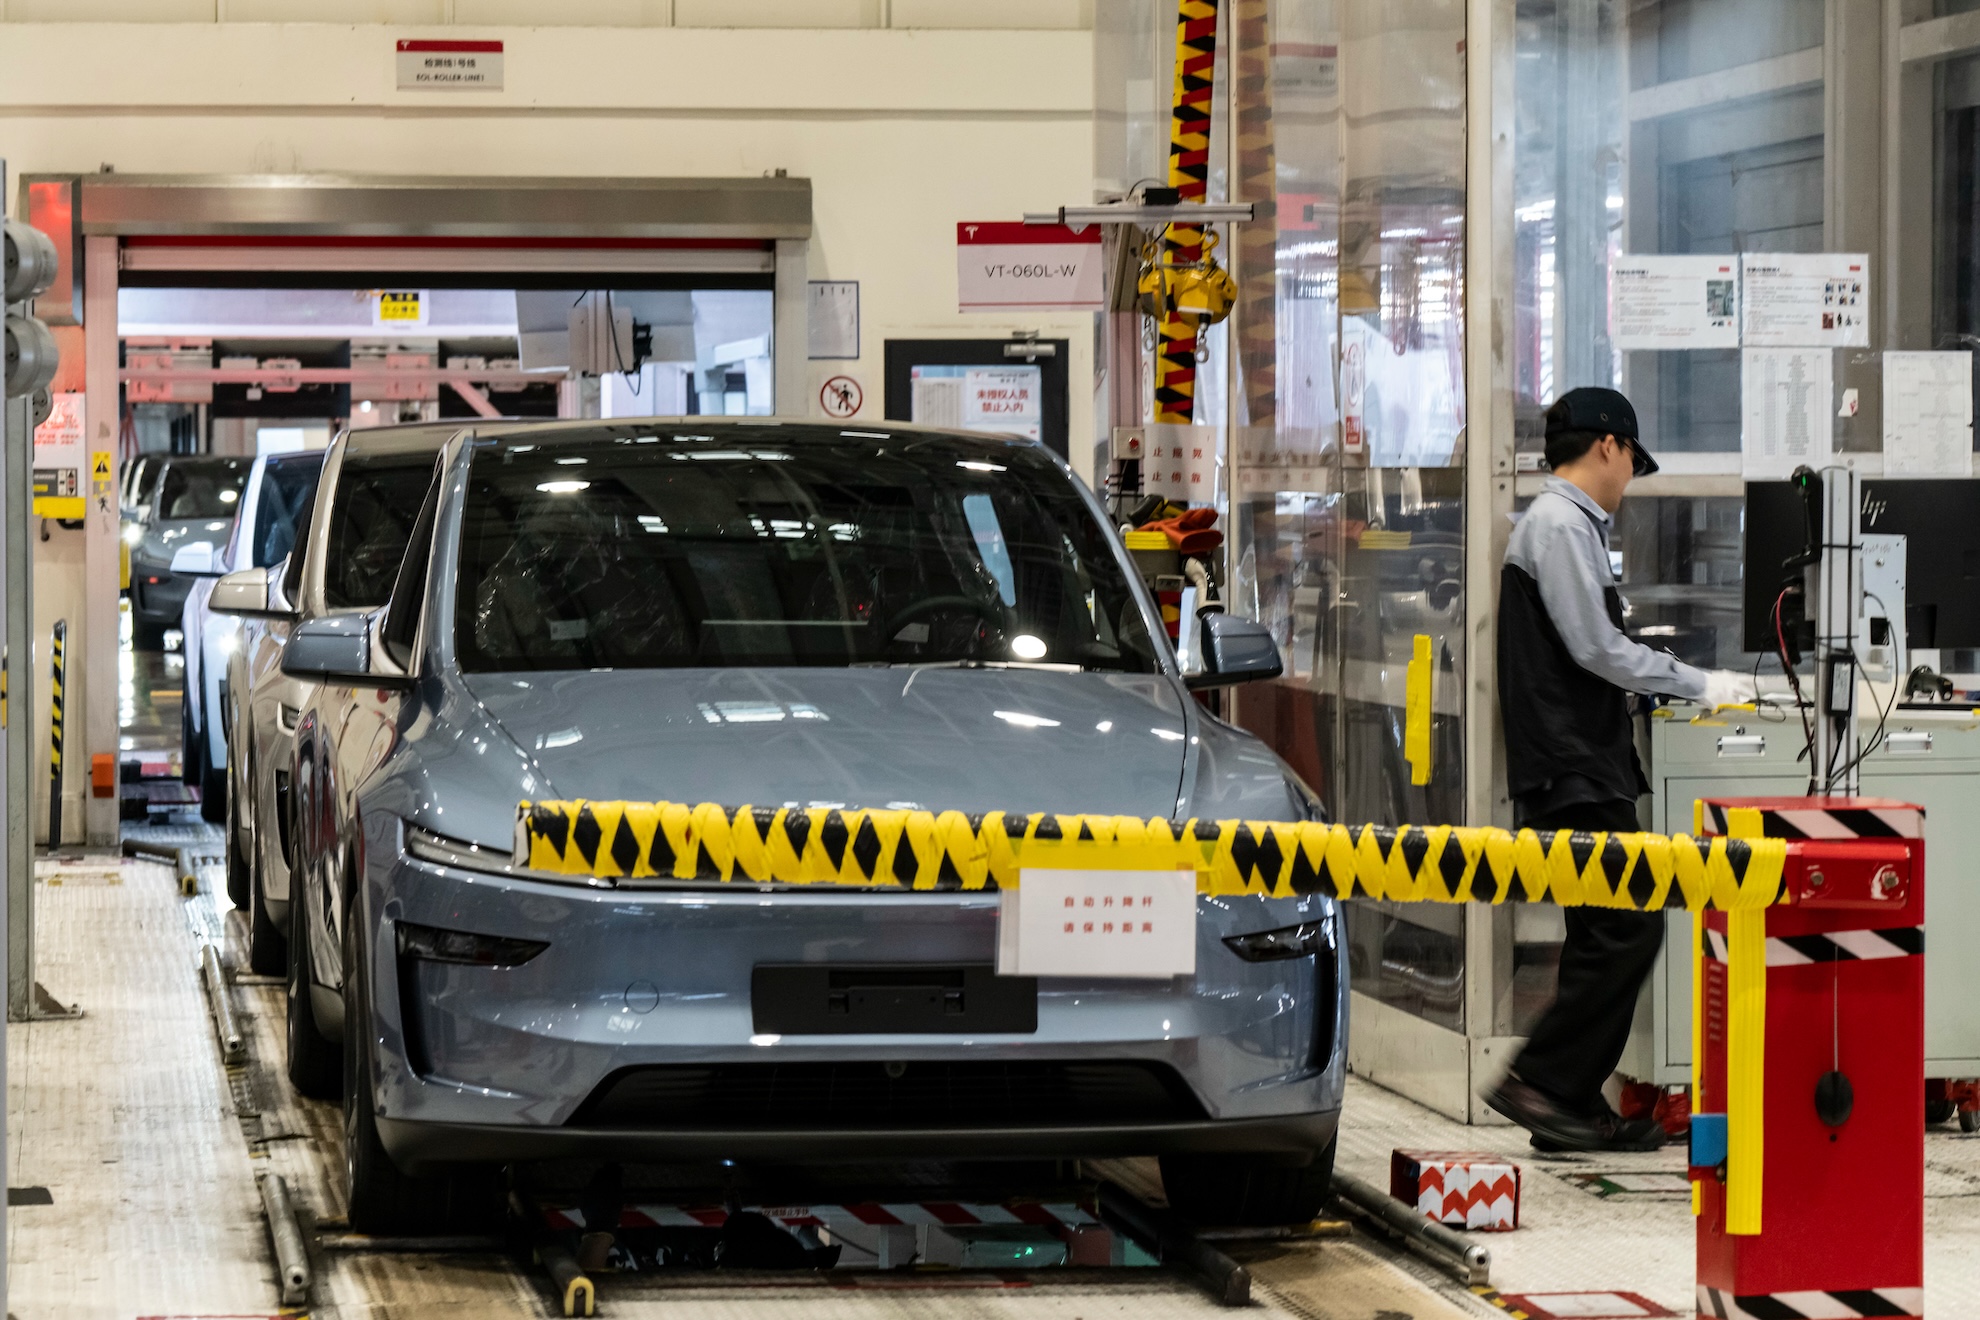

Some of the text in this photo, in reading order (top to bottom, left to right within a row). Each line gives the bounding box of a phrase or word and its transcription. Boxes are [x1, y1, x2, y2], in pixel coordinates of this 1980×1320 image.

[416, 73, 485, 82] EOL-ROLLER-LINE1
[984, 264, 1077, 278] VT-060L-W
[977, 388, 1029, 400] 未授权人员
[982, 401, 1024, 413] 禁止入内
[1861, 489, 1887, 527] hp
[1064, 896, 1153, 908] 自动升降杆
[1063, 922, 1153, 934] 请保持距离
